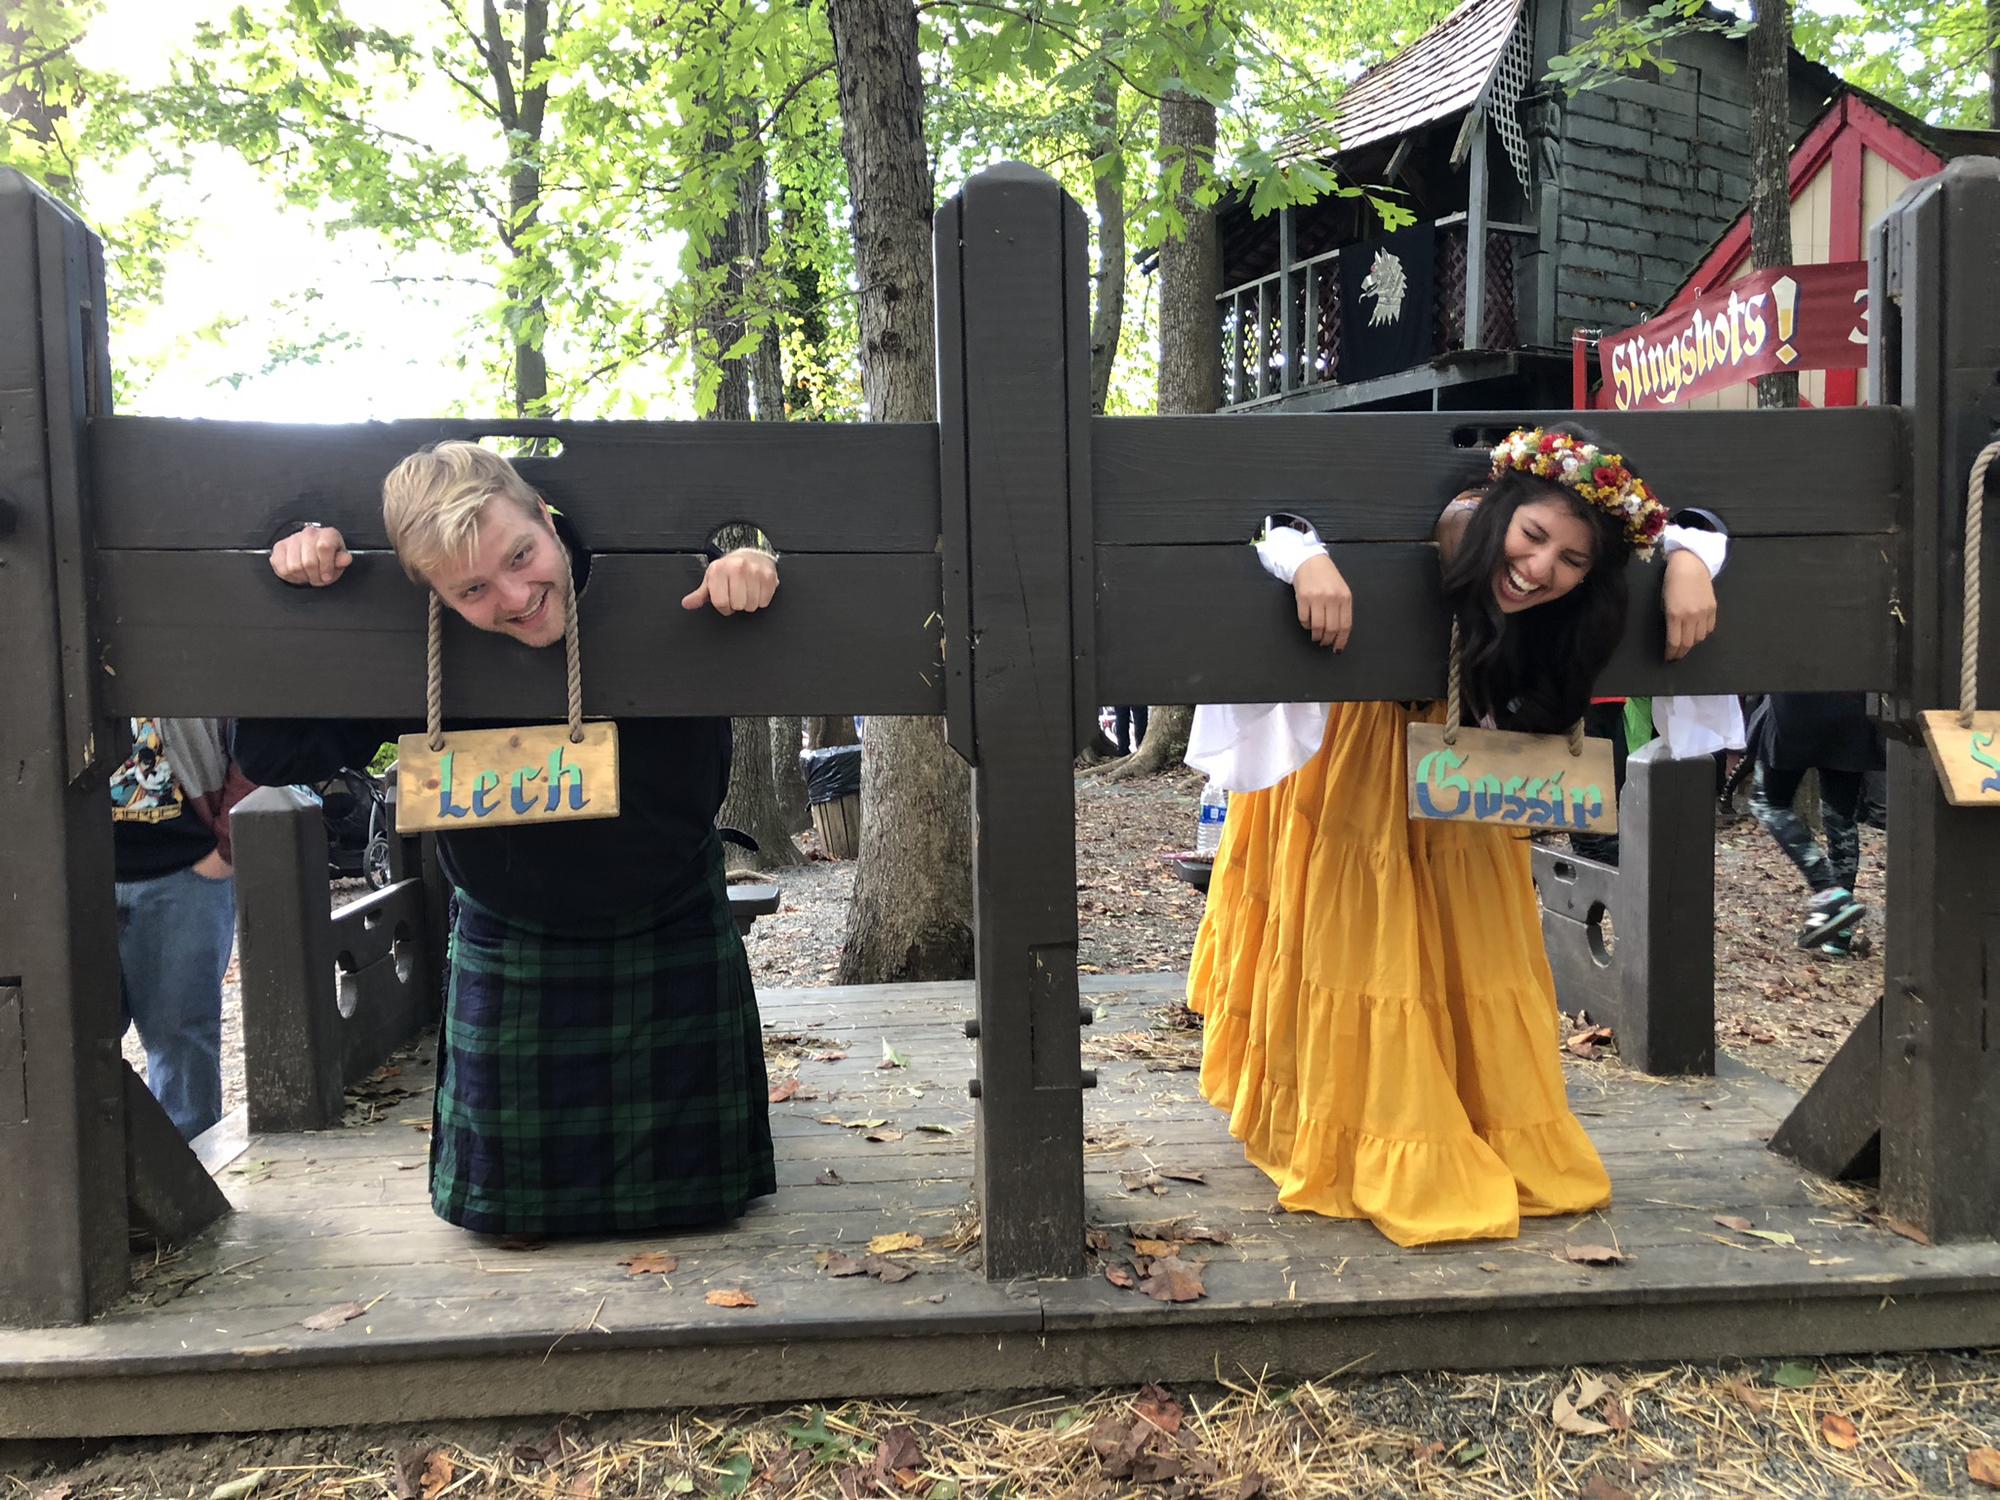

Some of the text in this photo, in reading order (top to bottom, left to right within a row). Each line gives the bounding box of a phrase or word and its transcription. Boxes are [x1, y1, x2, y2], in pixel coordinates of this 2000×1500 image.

[1611, 275, 1797, 411] Slingshots!
[437, 746, 591, 818] Lech
[1416, 747, 1603, 828] Gossip
